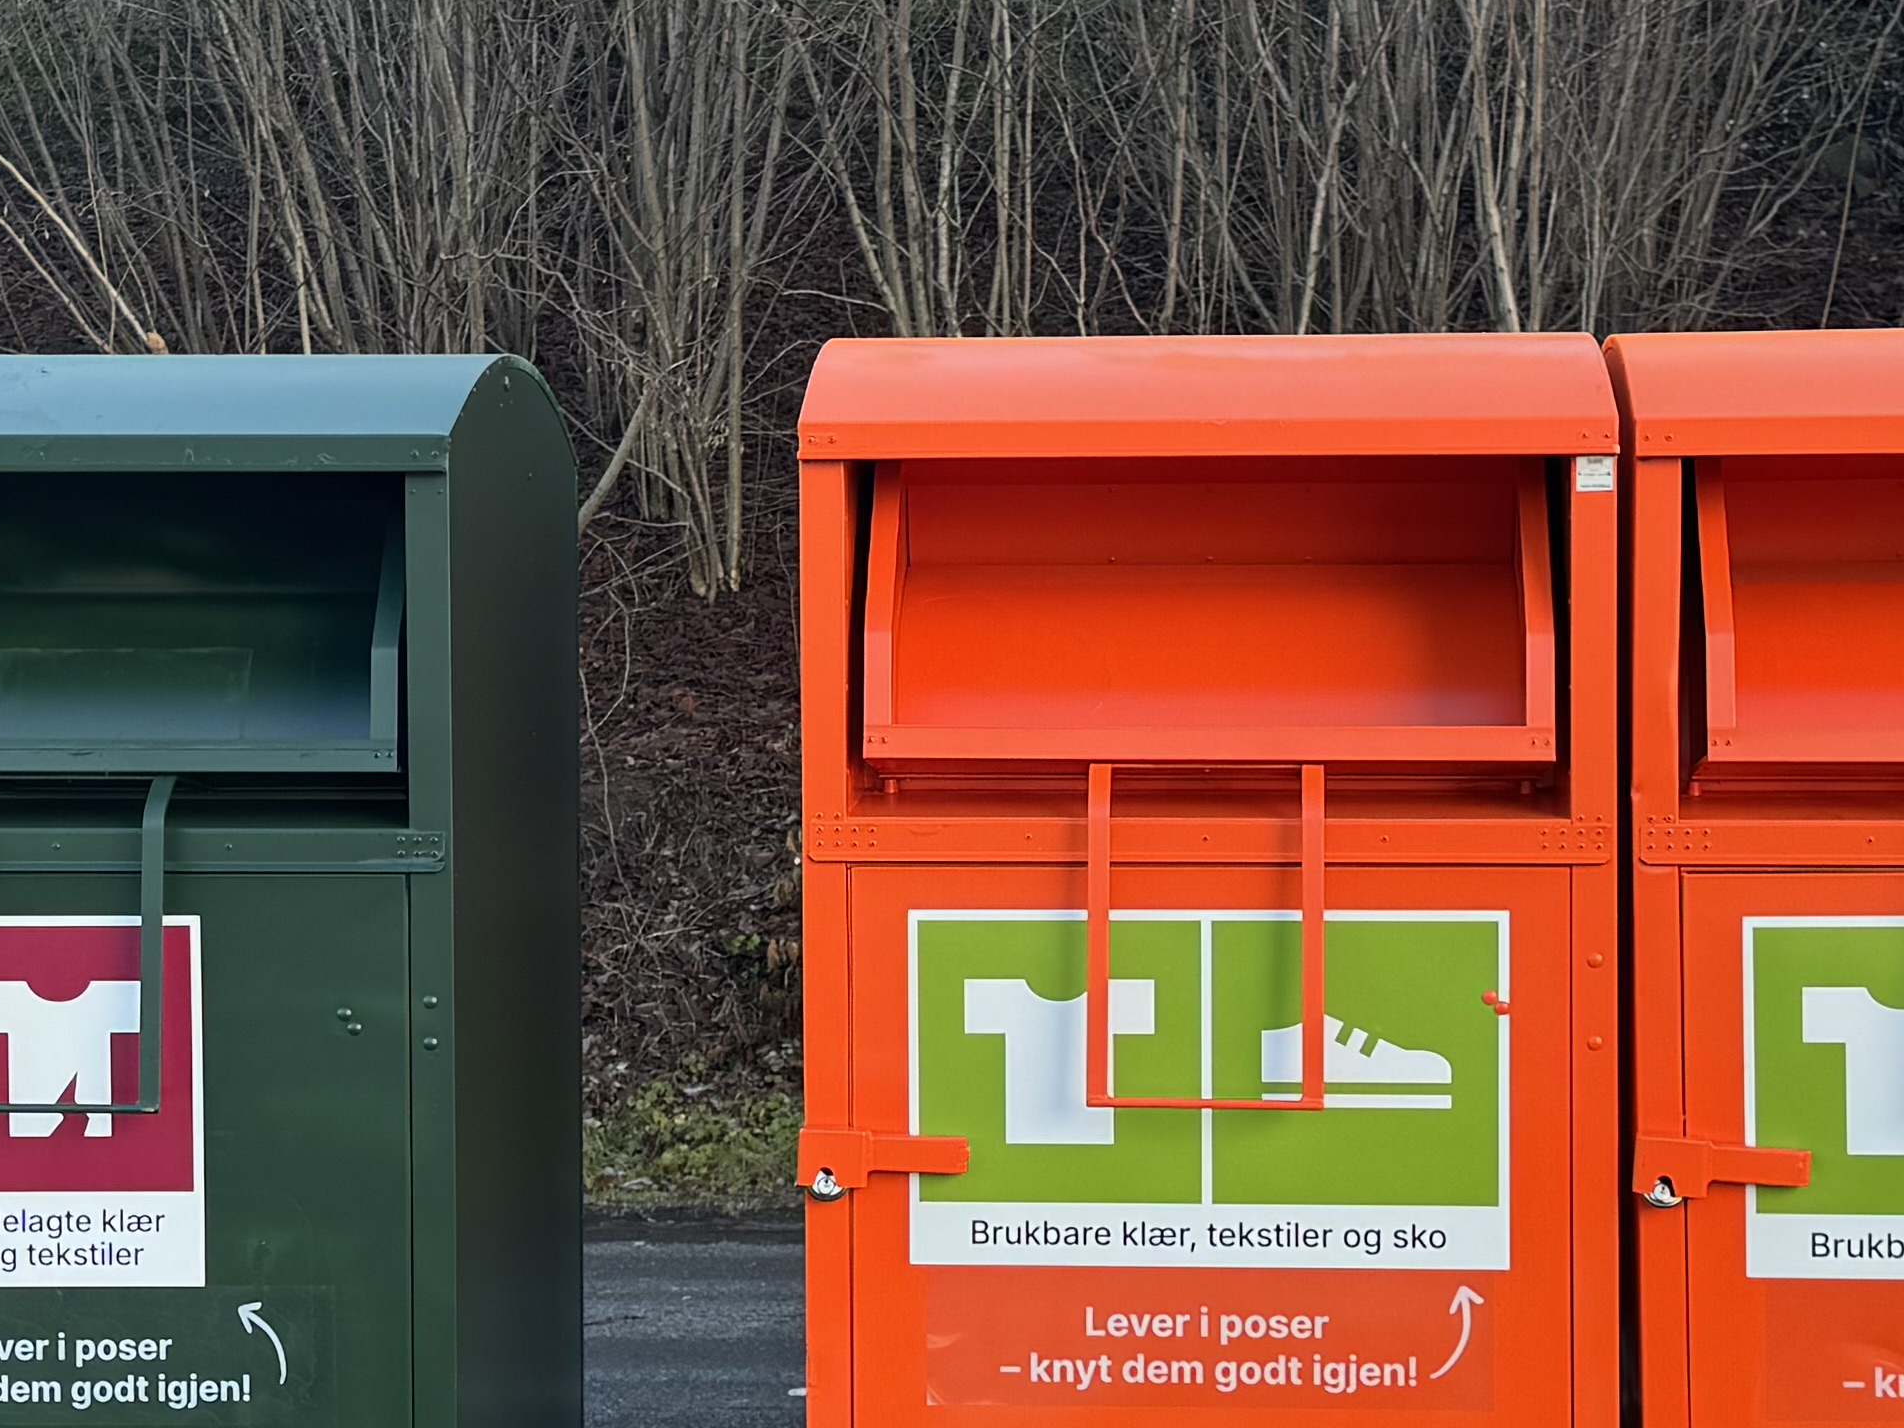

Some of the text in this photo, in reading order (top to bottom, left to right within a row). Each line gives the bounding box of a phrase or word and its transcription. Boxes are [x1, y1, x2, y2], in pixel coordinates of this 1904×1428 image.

[102, 1208, 166, 1233] klær
[971, 1219, 1447, 1256] Brukbare klær, tekstiler og sko
[27, 1242, 145, 1266] tekstiler
[1085, 1306, 1330, 1346] Lever i poser
[57, 1331, 66, 1361] i
[75, 1338, 173, 1368] poser
[70, 1374, 149, 1410] godt
[158, 1372, 251, 1410] igjen!
[1030, 1352, 1112, 1391] knyt
[1122, 1353, 1204, 1384] dem
[1214, 1354, 1303, 1393] godt
[1313, 1353, 1417, 1394] igjen!
